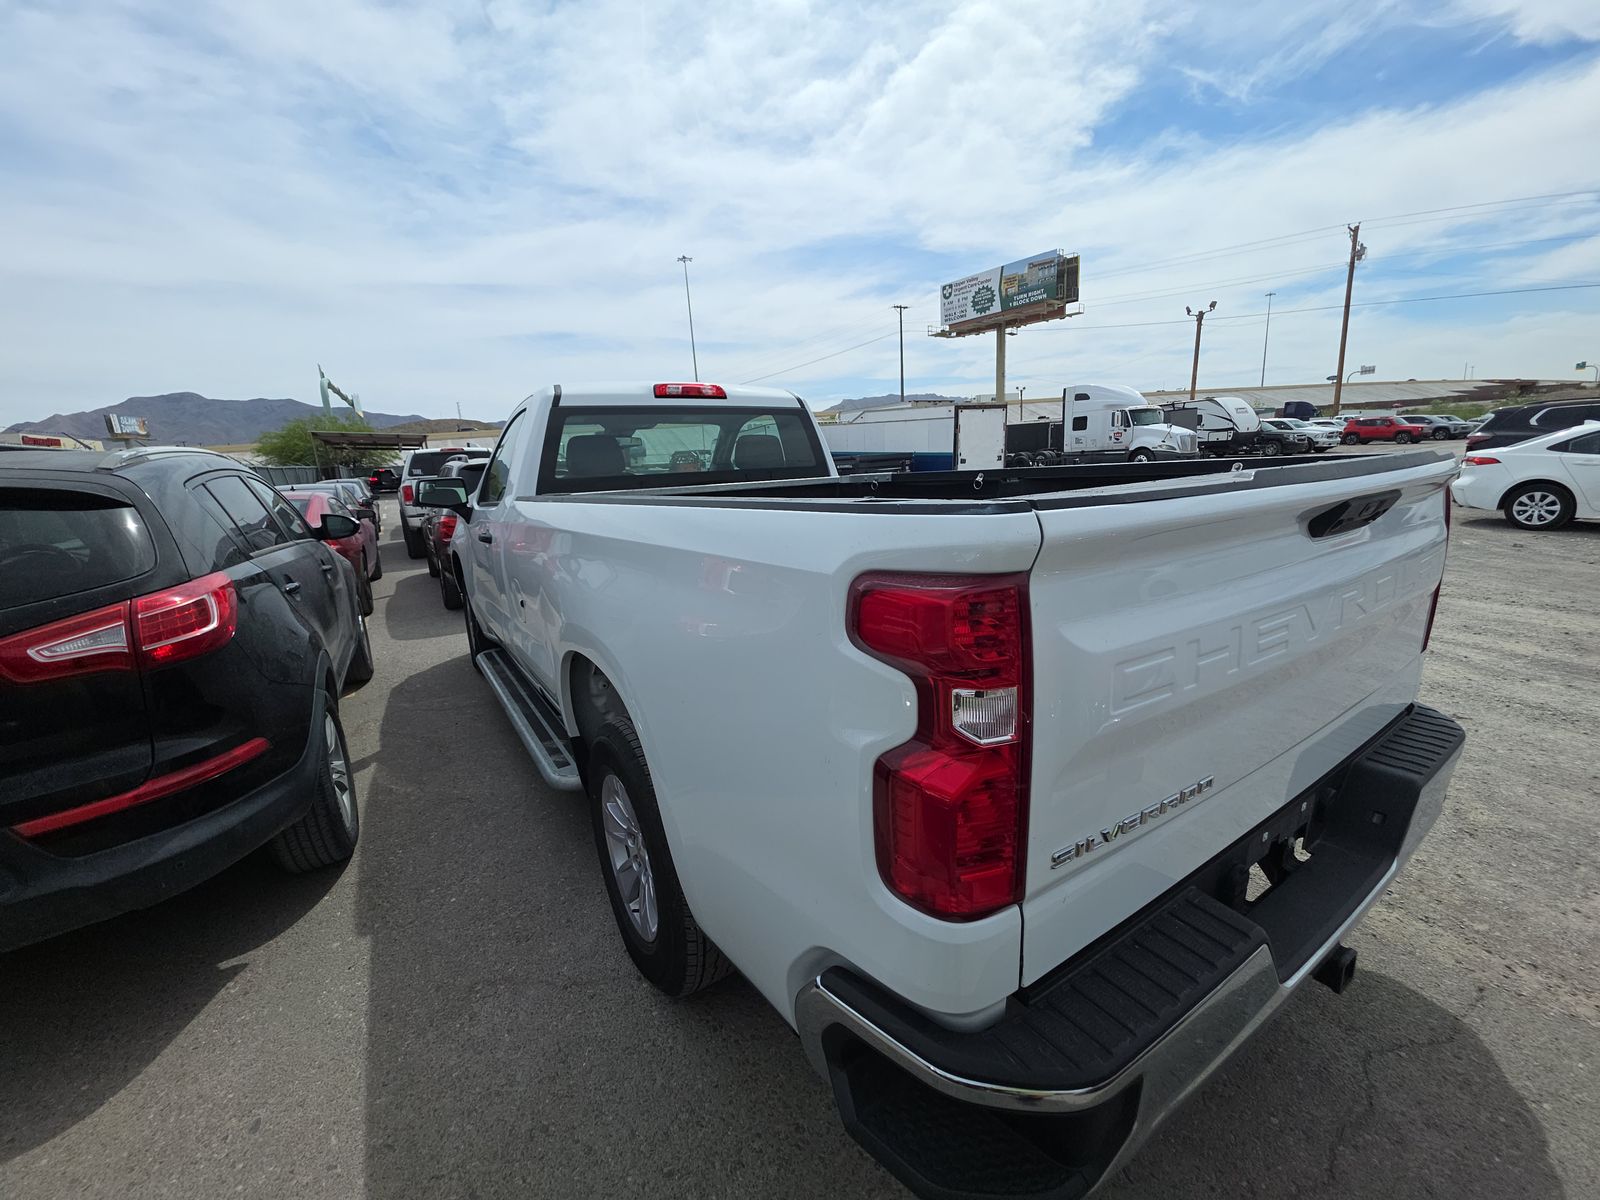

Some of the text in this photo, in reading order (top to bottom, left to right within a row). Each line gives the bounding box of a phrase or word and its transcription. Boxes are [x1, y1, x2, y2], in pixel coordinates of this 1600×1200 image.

[953, 280, 966, 288] Upper
[977, 278, 992, 286] Center
[1013, 288, 1045, 301] TURN RIGHT
[1013, 298, 1030, 306] BLOCK
[1030, 293, 1047, 302] DOWN
[944, 309, 968, 318] WALK-INS
[944, 313, 967, 323] WELCOME
[1109, 549, 1442, 715] CHEVROLE
[1050, 775, 1215, 870] SILVERADO
